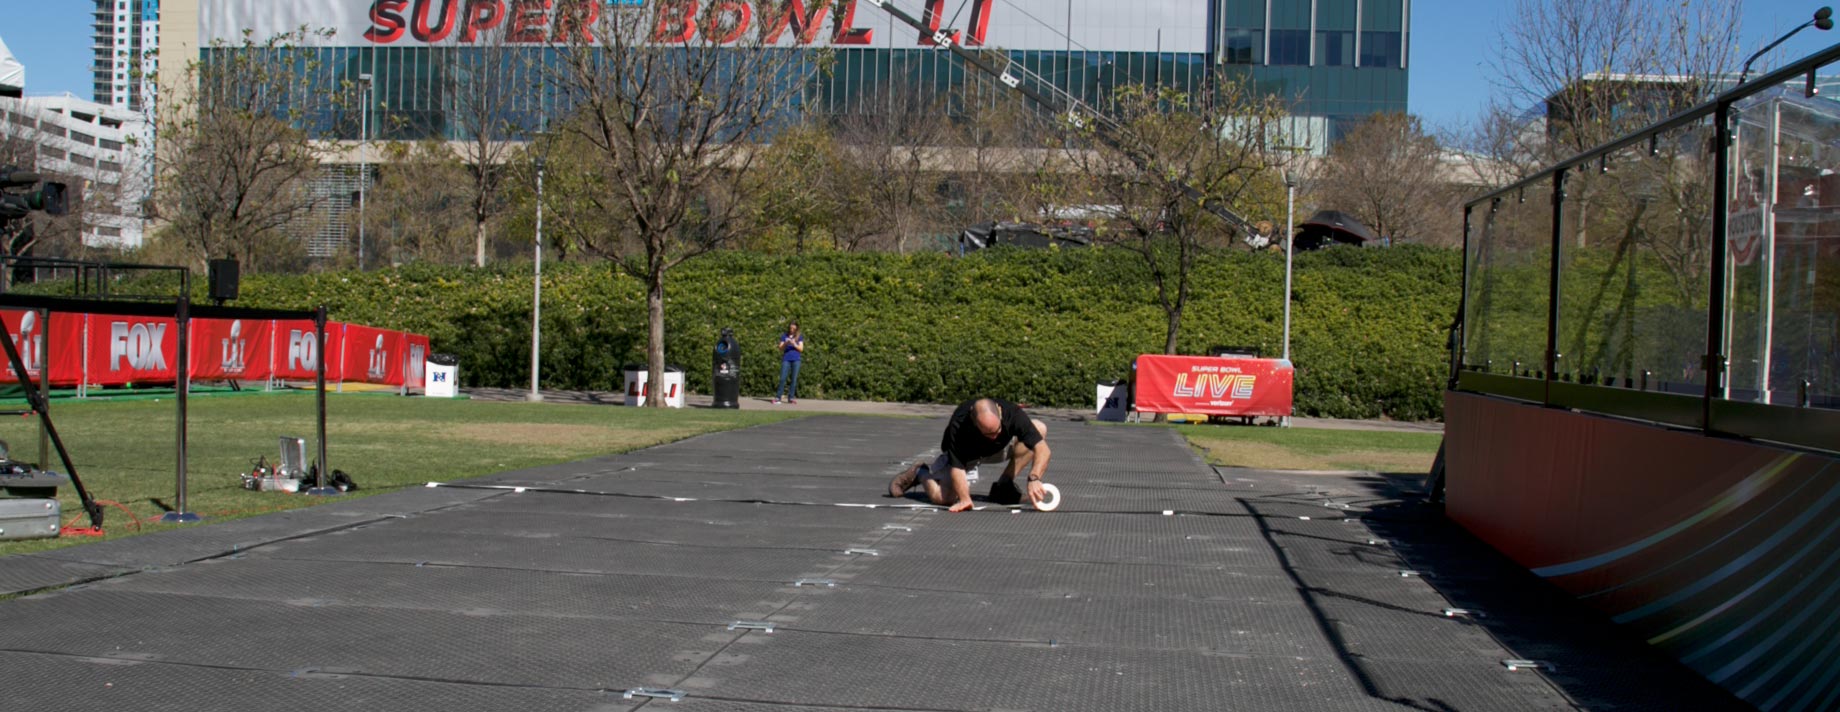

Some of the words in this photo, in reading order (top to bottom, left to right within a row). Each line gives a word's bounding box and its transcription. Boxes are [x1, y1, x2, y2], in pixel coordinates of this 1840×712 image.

[363, 0, 600, 43] SUPER
[648, 0, 873, 44] BOWL
[917, 0, 993, 46] LI
[111, 322, 167, 371] FOX
[1174, 373, 1256, 399] LIVE
